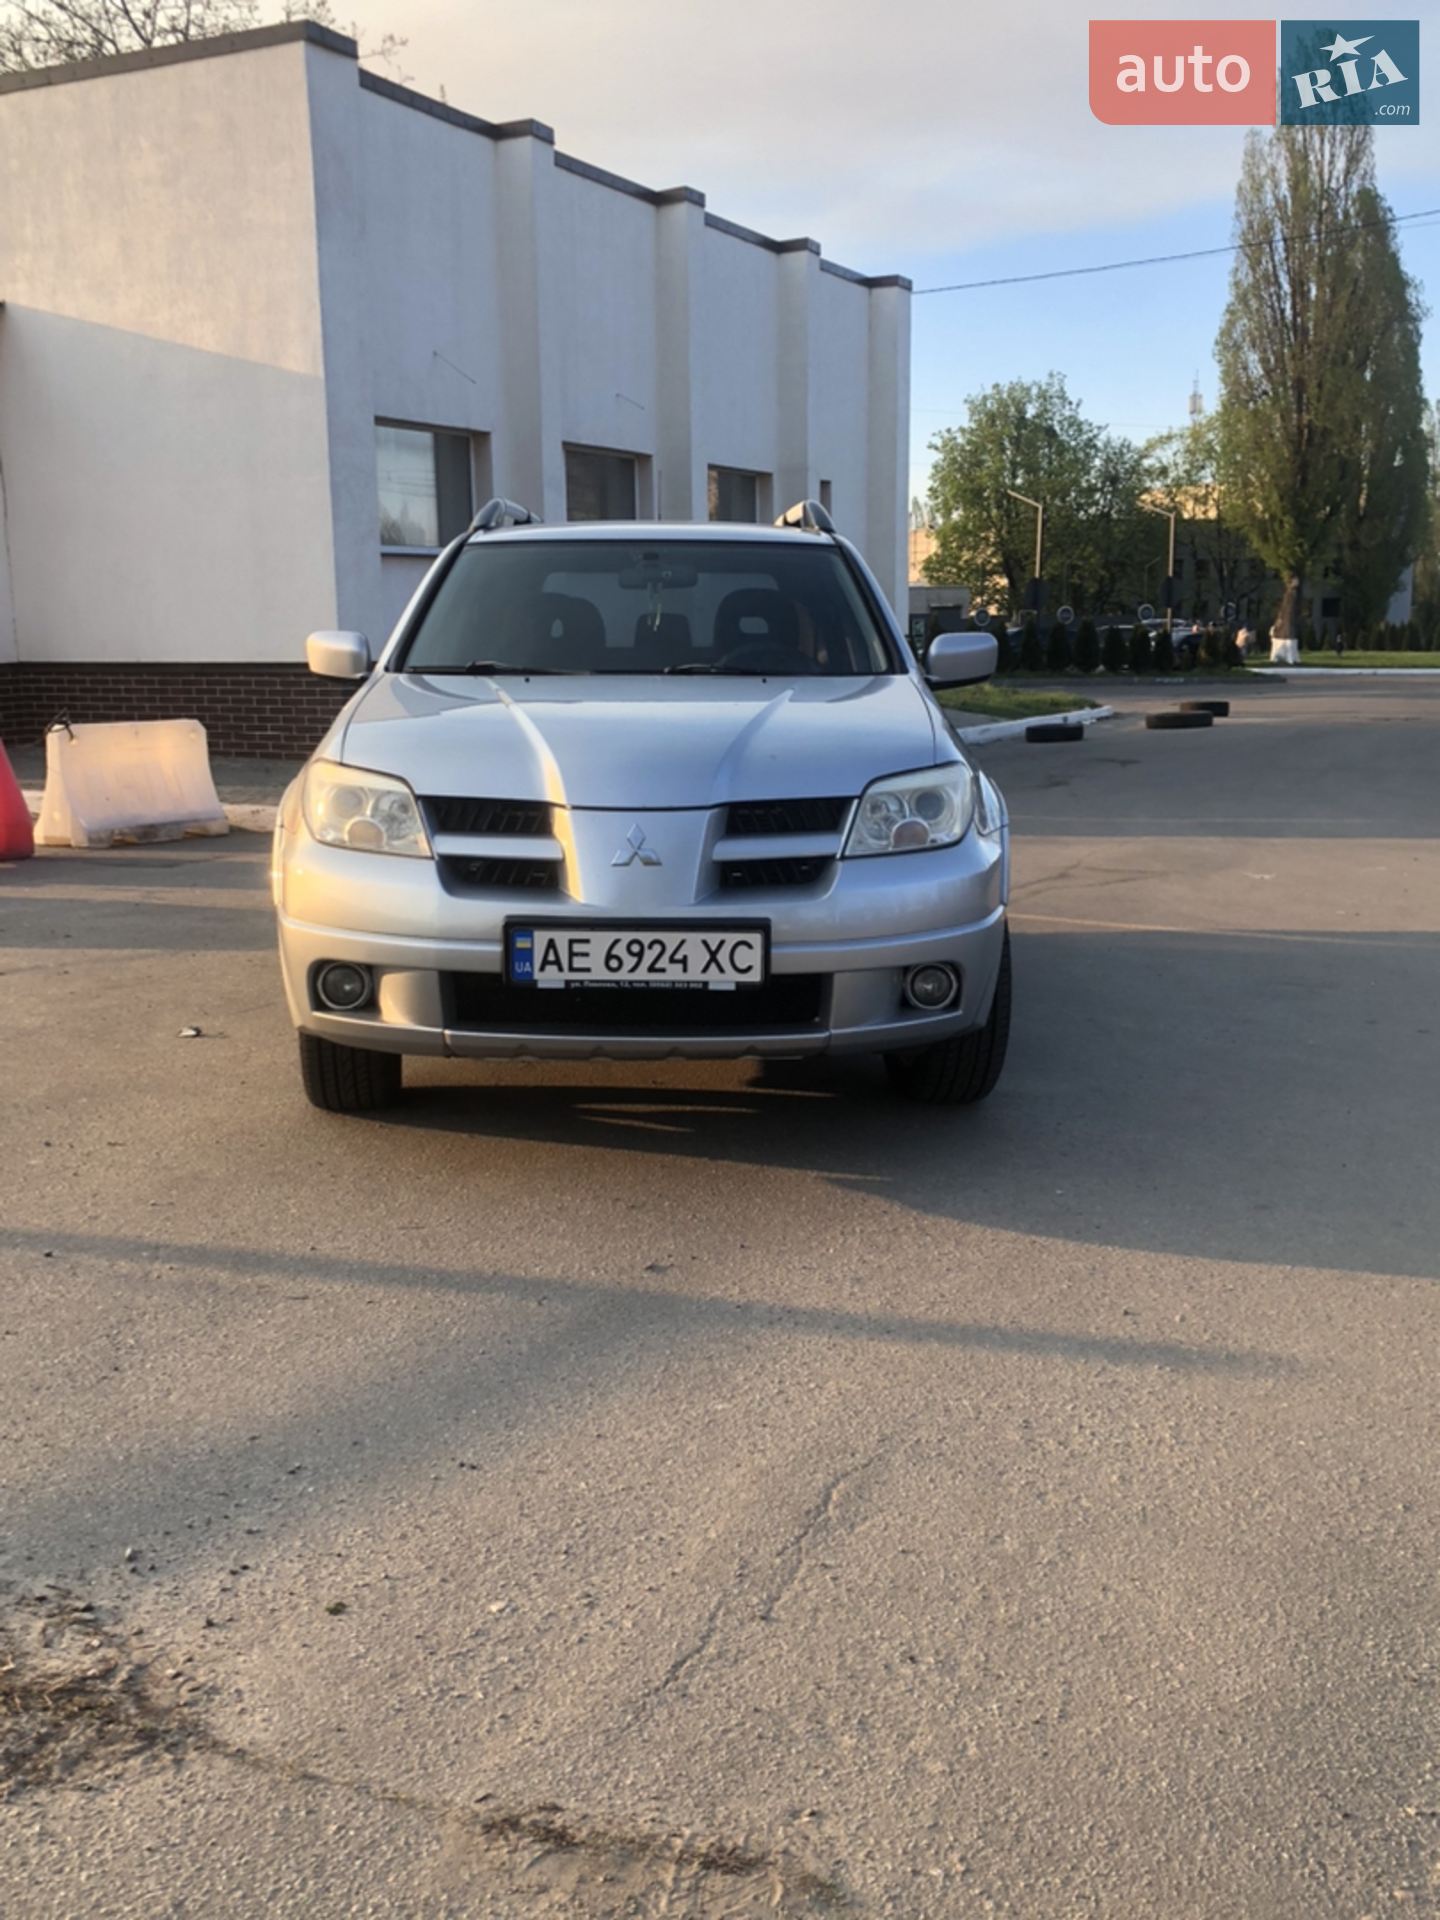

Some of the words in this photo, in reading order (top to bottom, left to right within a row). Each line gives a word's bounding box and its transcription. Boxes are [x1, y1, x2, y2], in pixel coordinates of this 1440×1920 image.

[515, 961, 533, 973] UA
[538, 938, 592, 973] AE
[603, 938, 689, 974] 6924
[700, 938, 755, 975] XC
